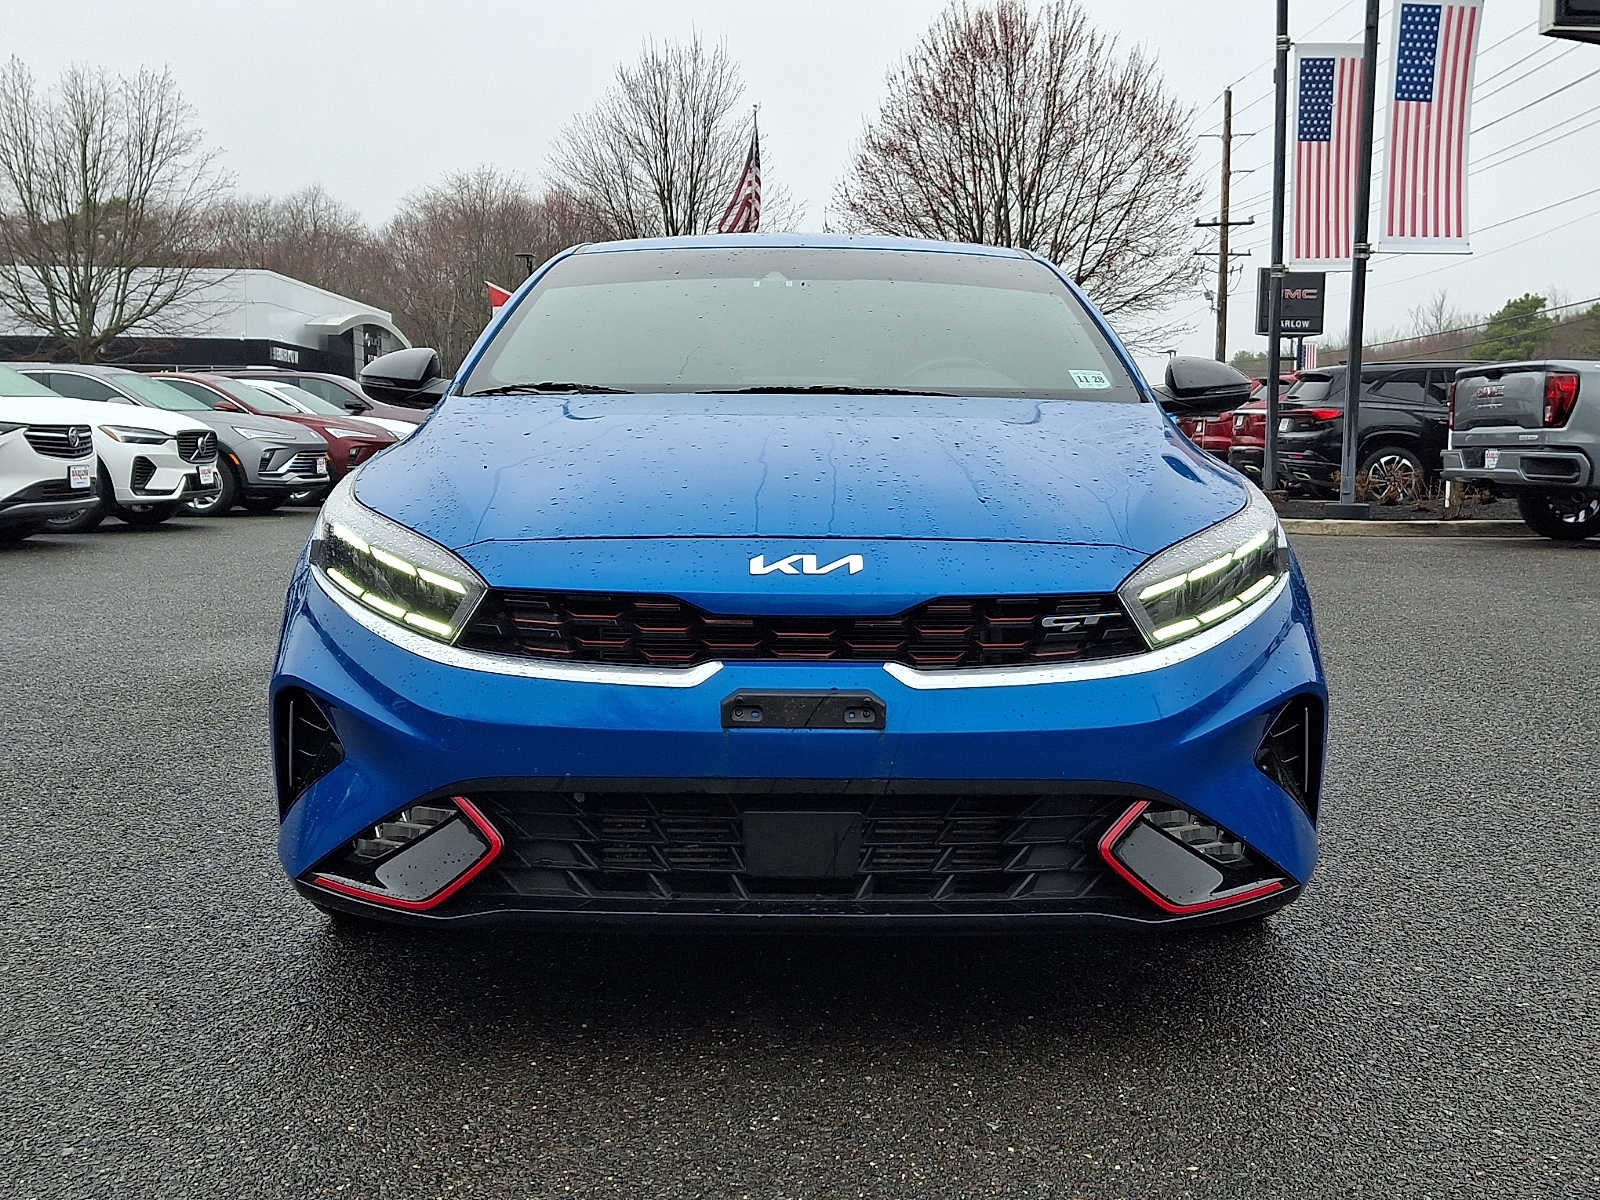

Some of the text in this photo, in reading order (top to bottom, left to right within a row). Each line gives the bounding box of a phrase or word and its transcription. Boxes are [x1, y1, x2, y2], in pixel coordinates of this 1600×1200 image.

[1282, 288, 1318, 299] MC
[1280, 319, 1310, 328] ARLOW
[749, 553, 864, 575] KIA
[1041, 612, 1122, 632] GT
